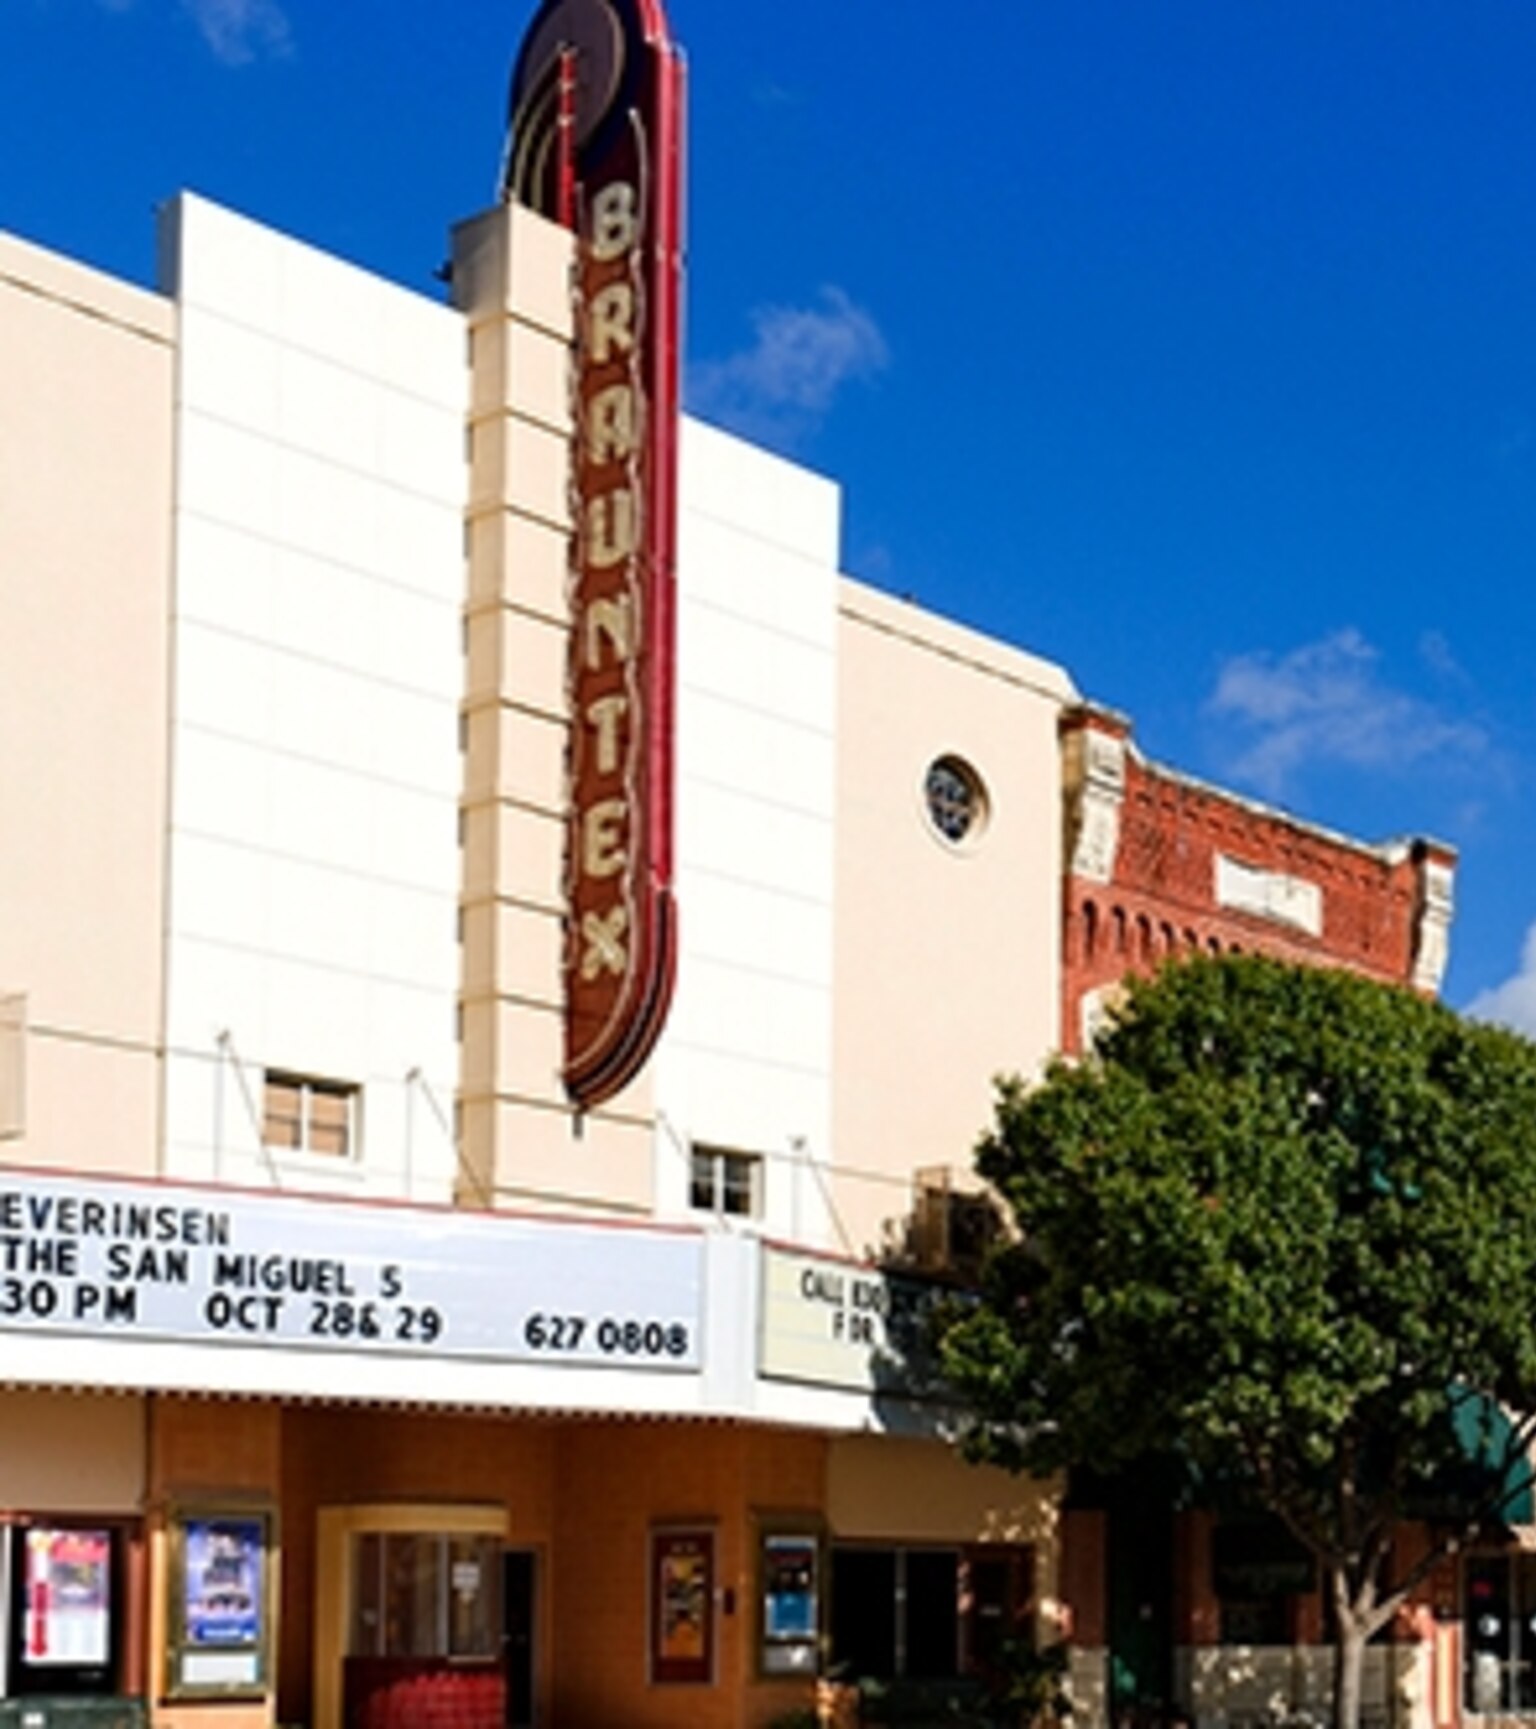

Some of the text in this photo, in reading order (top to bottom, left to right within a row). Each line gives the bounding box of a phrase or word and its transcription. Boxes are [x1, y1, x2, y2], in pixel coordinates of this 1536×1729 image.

[581, 179, 638, 980] BRAUNTEX
[0, 1193, 231, 1247] EVERINSEN
[3, 1236, 77, 1277] THE
[107, 1244, 188, 1284] SAN
[213, 1252, 354, 1297] MIGUEL
[1, 1279, 57, 1319] 30
[74, 1284, 137, 1323] PM
[206, 1291, 282, 1331] OCT
[396, 1305, 441, 1343] 29
[525, 1311, 586, 1350] 627
[597, 1318, 688, 1358] 0808
